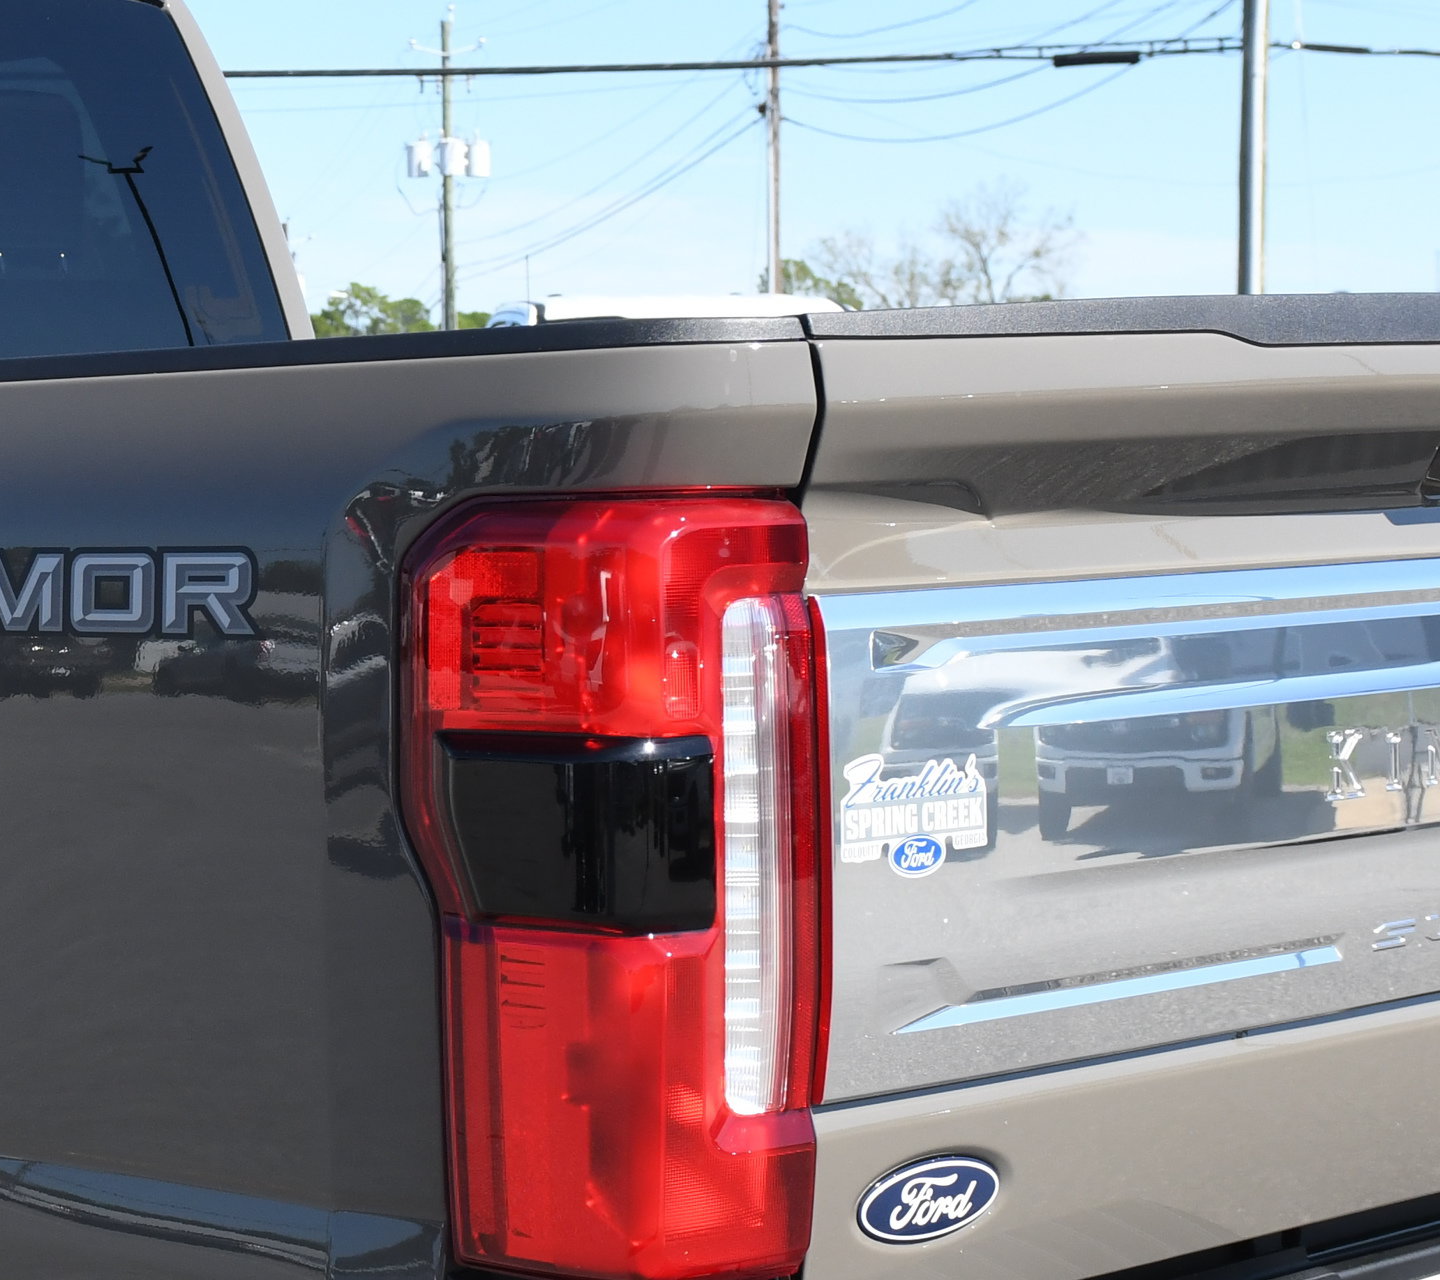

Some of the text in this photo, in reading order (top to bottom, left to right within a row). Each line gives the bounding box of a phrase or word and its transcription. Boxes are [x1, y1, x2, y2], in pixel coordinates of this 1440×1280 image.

[845, 757, 980, 809] Franklin's
[845, 796, 984, 841] SPRING CREEK
[900, 840, 936, 869] Ford
[889, 1173, 978, 1231] Ford
